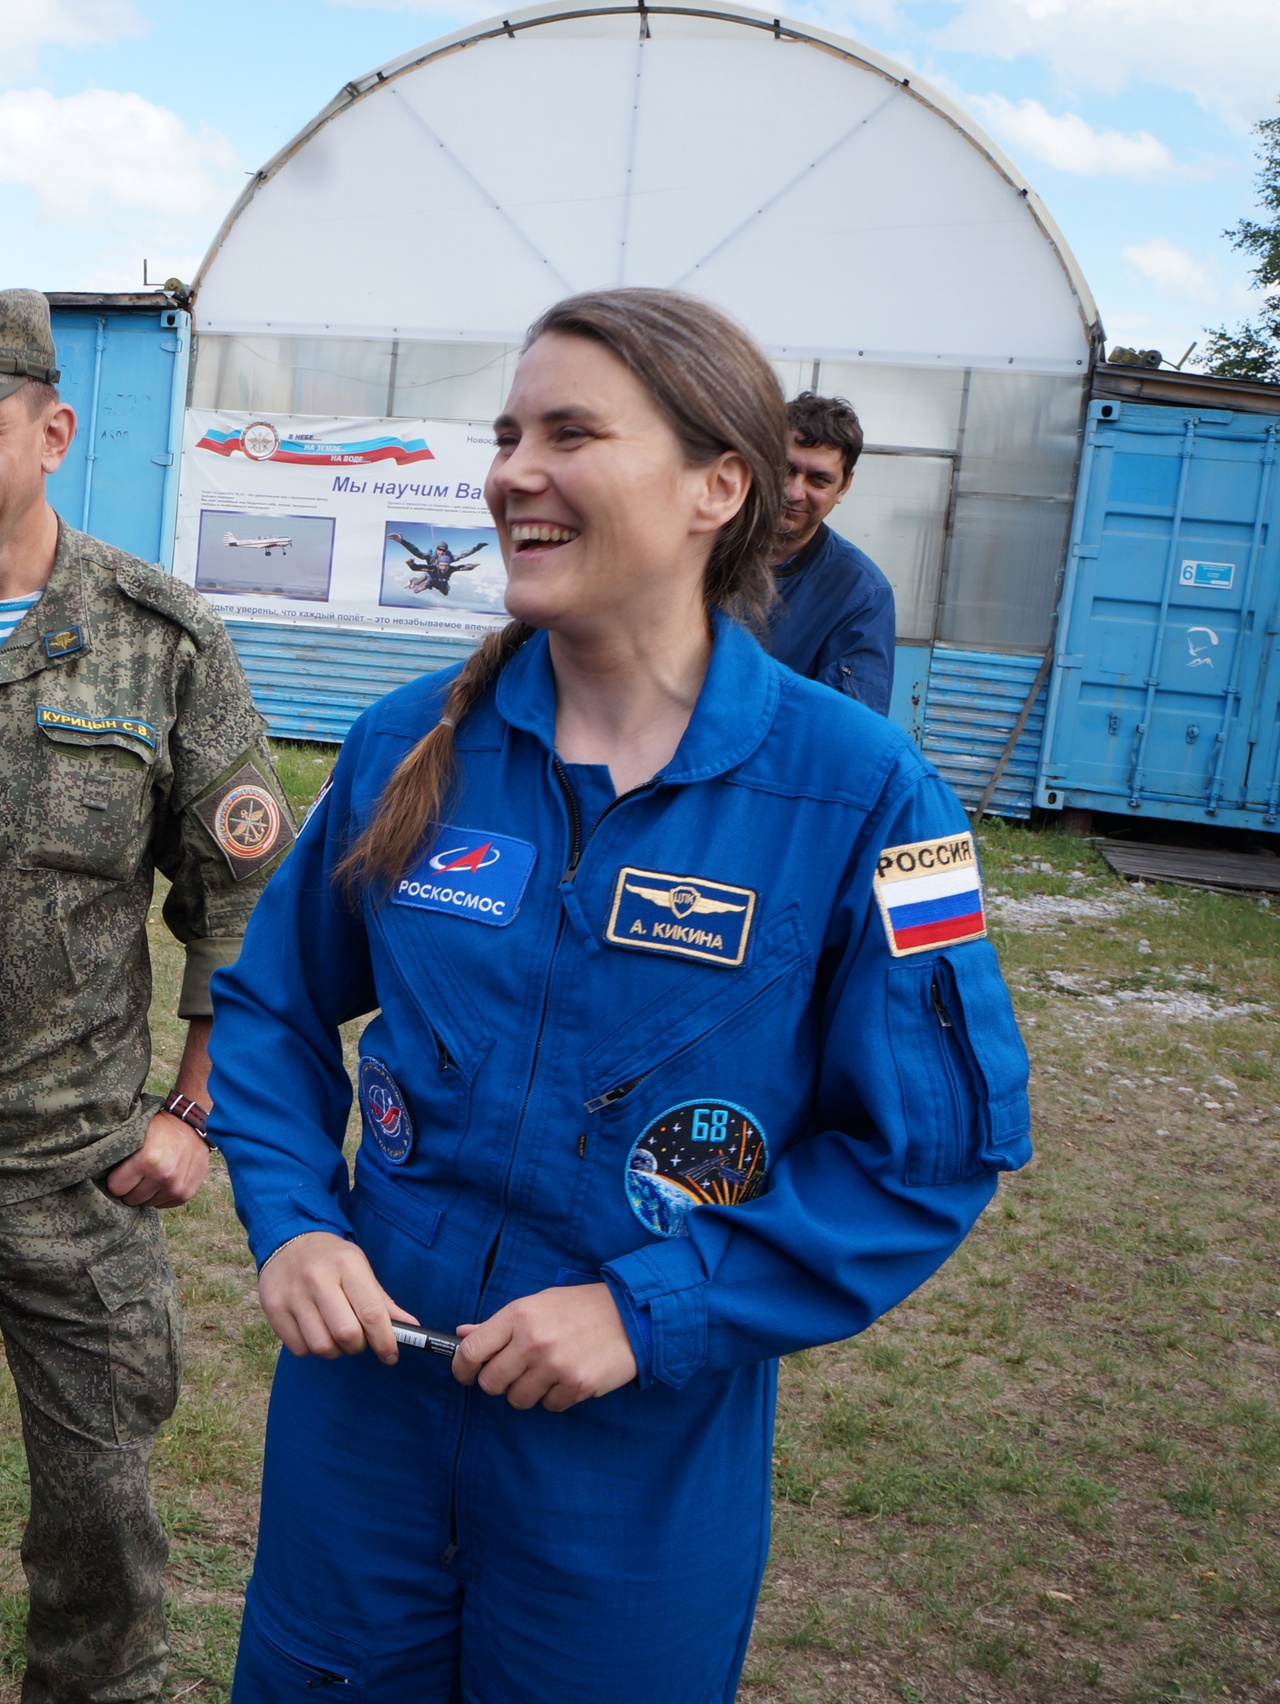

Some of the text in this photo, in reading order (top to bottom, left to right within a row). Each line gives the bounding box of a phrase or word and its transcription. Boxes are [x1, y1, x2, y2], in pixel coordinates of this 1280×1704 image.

[467, 436, 495, 445] Новос
[332, 476, 482, 500] Мы научим Ва
[1182, 565, 1194, 580] 6
[212, 604, 234, 612] дьте
[236, 606, 279, 616] уверены,
[299, 611, 335, 620] каждый
[337, 613, 365, 622] полёт
[375, 616, 390, 624] это
[393, 617, 462, 629] незабываемое
[43, 710, 151, 739] КУРИЦЫН С.В.
[876, 840, 972, 878] РОССИЯ
[398, 880, 506, 916] РОСКОСМОС
[629, 919, 723, 950] А. КИКИНА
[691, 1108, 729, 1143] 68
